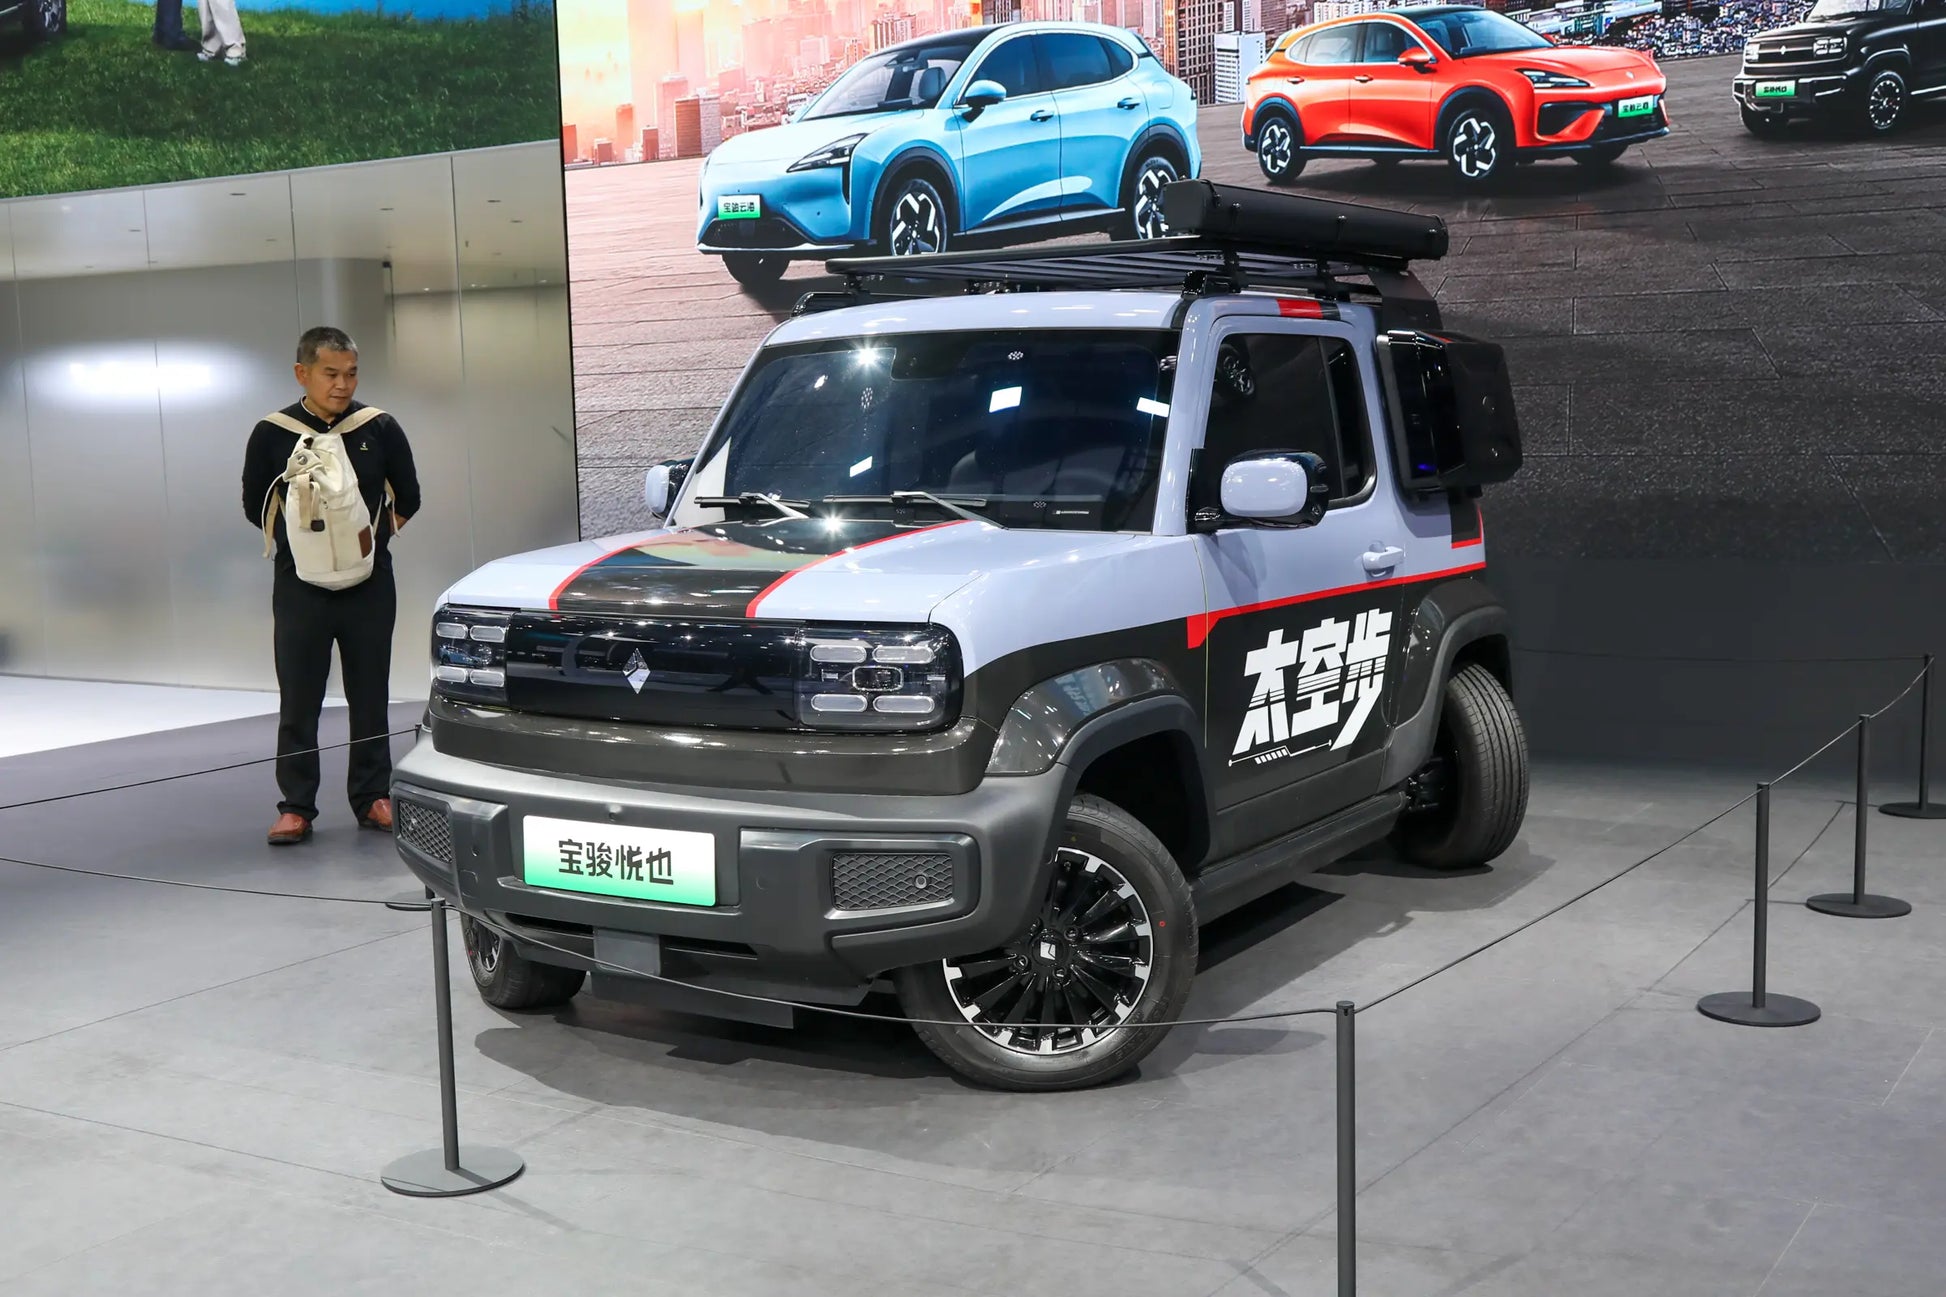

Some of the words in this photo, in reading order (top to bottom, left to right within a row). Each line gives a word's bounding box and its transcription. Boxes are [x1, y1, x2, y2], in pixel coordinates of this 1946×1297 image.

[1232, 608, 1393, 756] 太空步
[558, 838, 674, 886] 宝骏悦也
